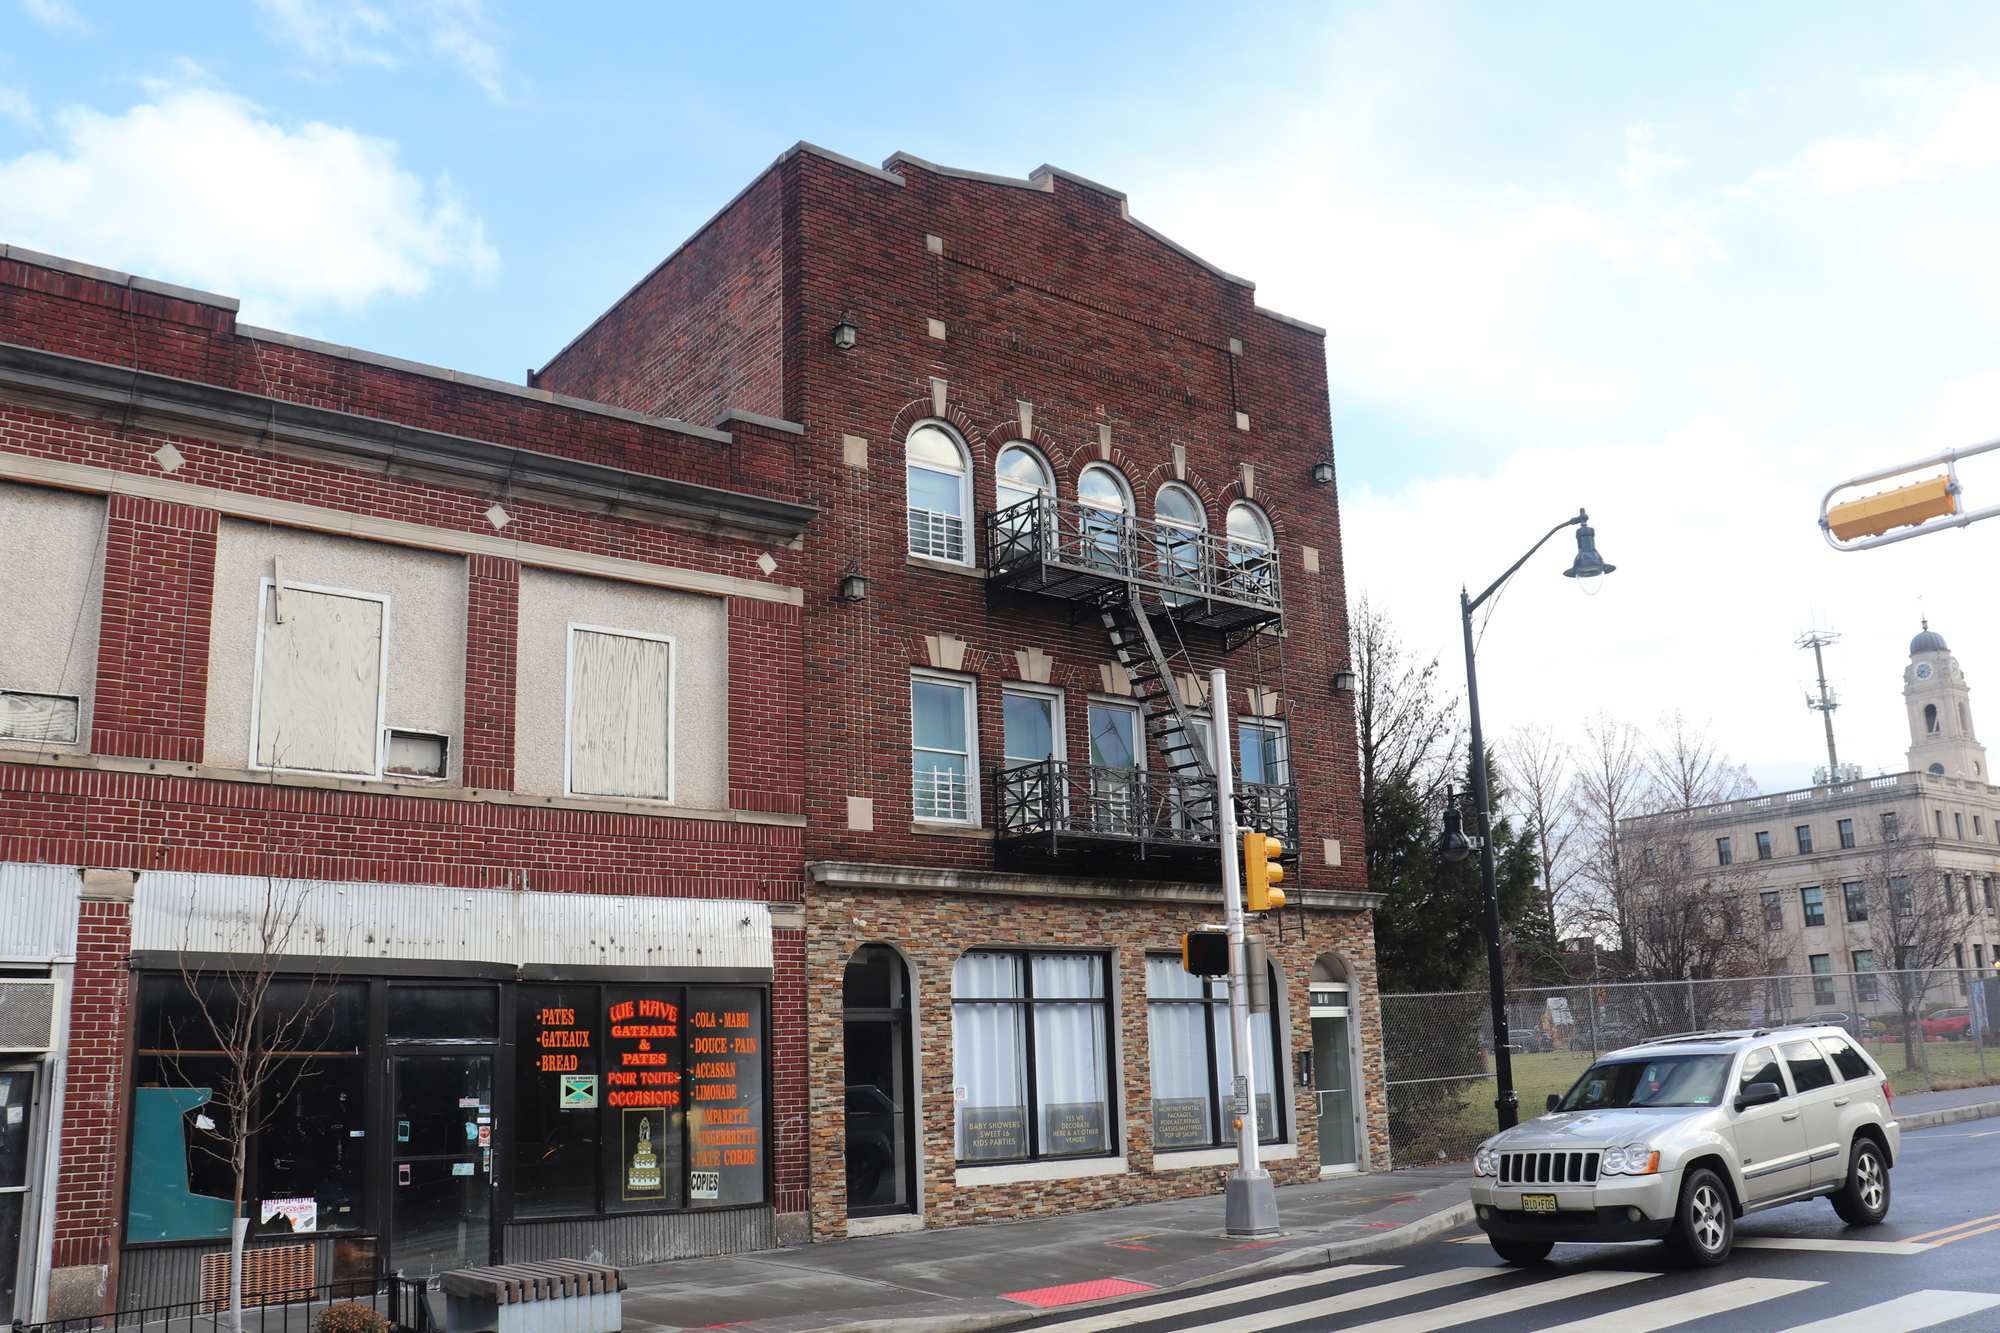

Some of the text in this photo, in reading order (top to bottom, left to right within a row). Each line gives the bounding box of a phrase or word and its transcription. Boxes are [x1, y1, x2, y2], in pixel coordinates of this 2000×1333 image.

[541, 1008, 576, 1025] PATES
[610, 999, 678, 1023] WE HAVE
[695, 1011, 717, 1028] COLA
[541, 1030, 591, 1048] GATEAUX
[611, 1025, 678, 1038] GATEAUX
[639, 1038, 651, 1051] &
[694, 1036, 758, 1054] DOUCE PAIN
[541, 1054, 578, 1072] BREAD
[622, 1053, 668, 1066] PATES
[607, 1071, 638, 1085] POUR
[640, 1071, 681, 1085] TOUTES
[695, 1062, 737, 1079] ACCASSAN
[607, 1091, 681, 1106] OCCASIONS
[695, 1084, 737, 1101] LIMONADE
[969, 1121, 987, 1130] BABY
[980, 1129, 1001, 1138] SWEET
[972, 1137, 1017, 1148] KIDS PARTIES
[691, 1172, 718, 1192] COPIES
